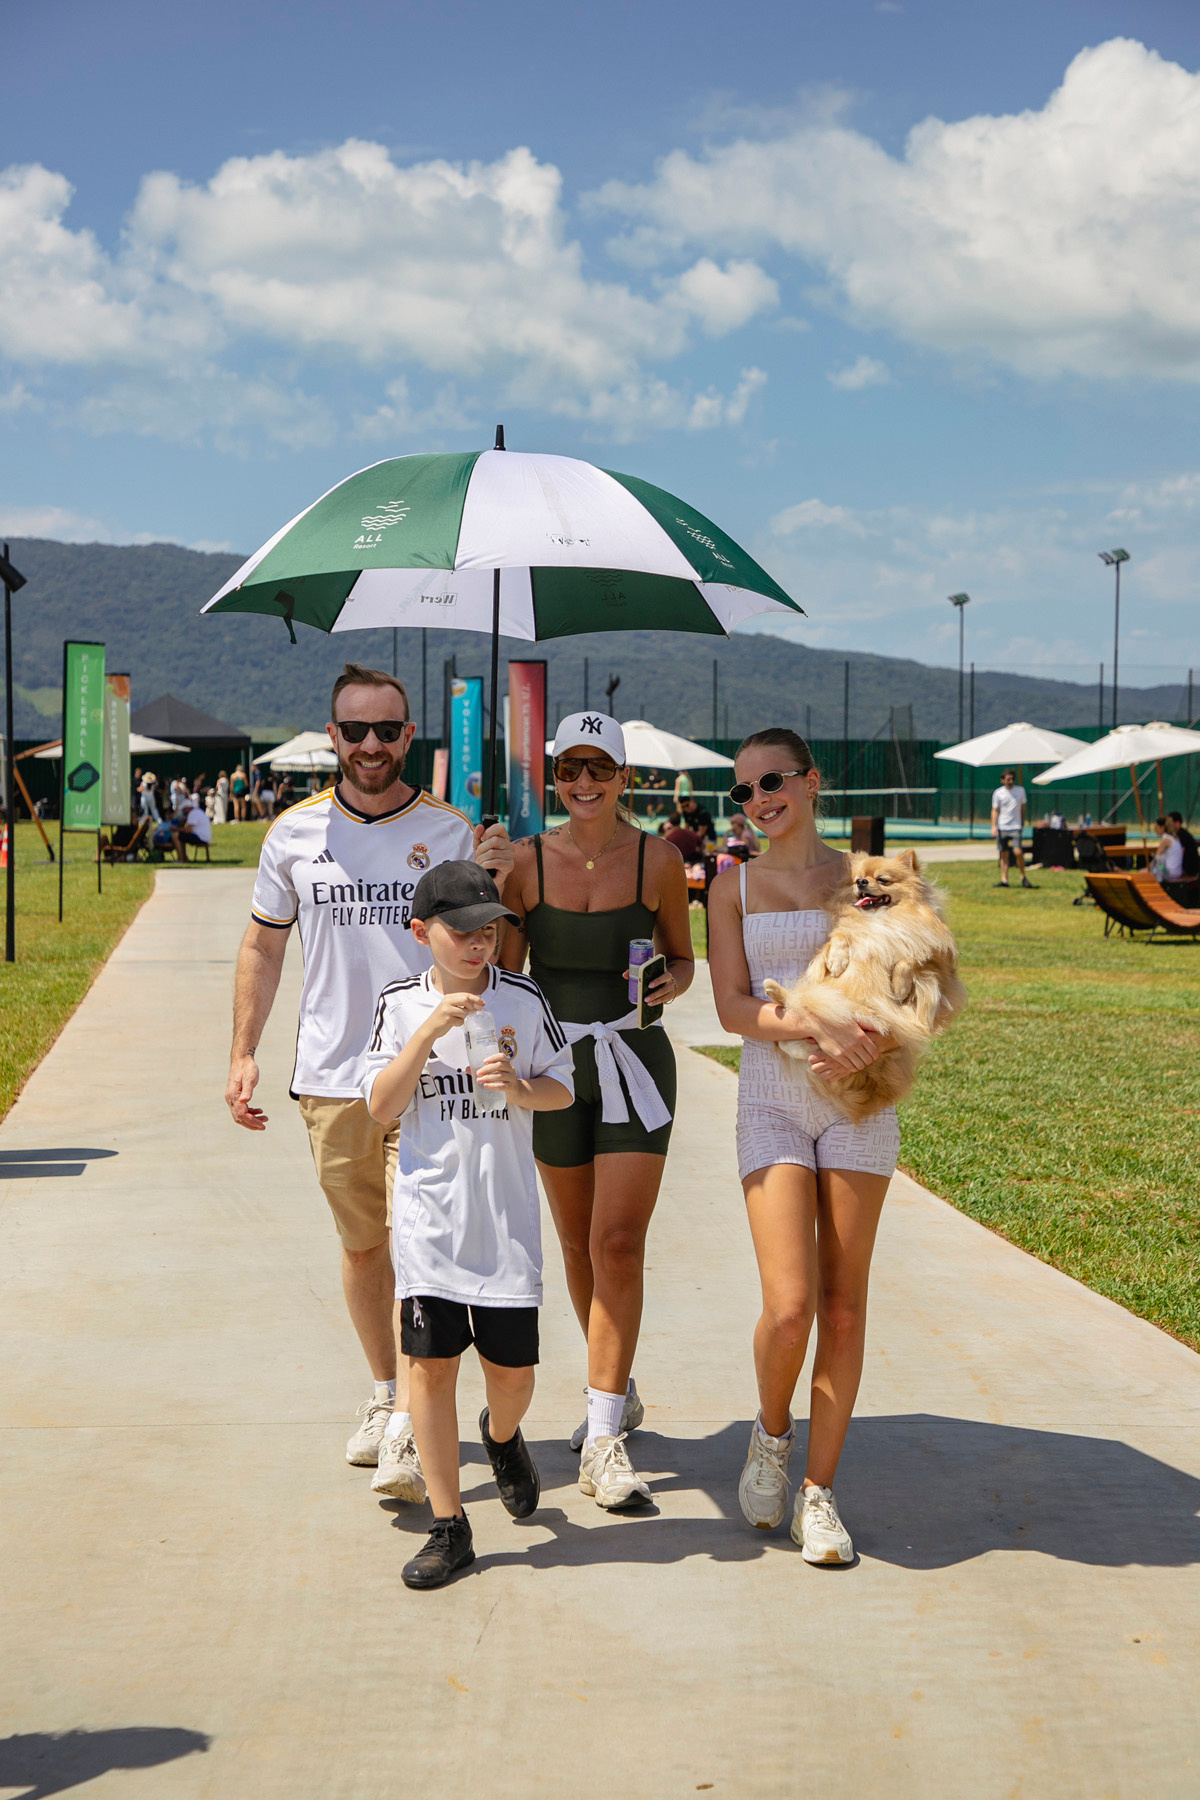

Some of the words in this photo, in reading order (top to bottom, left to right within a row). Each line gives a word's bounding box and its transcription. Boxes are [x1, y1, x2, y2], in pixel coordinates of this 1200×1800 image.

[354, 533, 382, 543] ALL
[580, 716, 603, 735] NY
[311, 878, 415, 905] Emirate
[332, 906, 354, 926] FLY
[359, 905, 409, 925] BETTER
